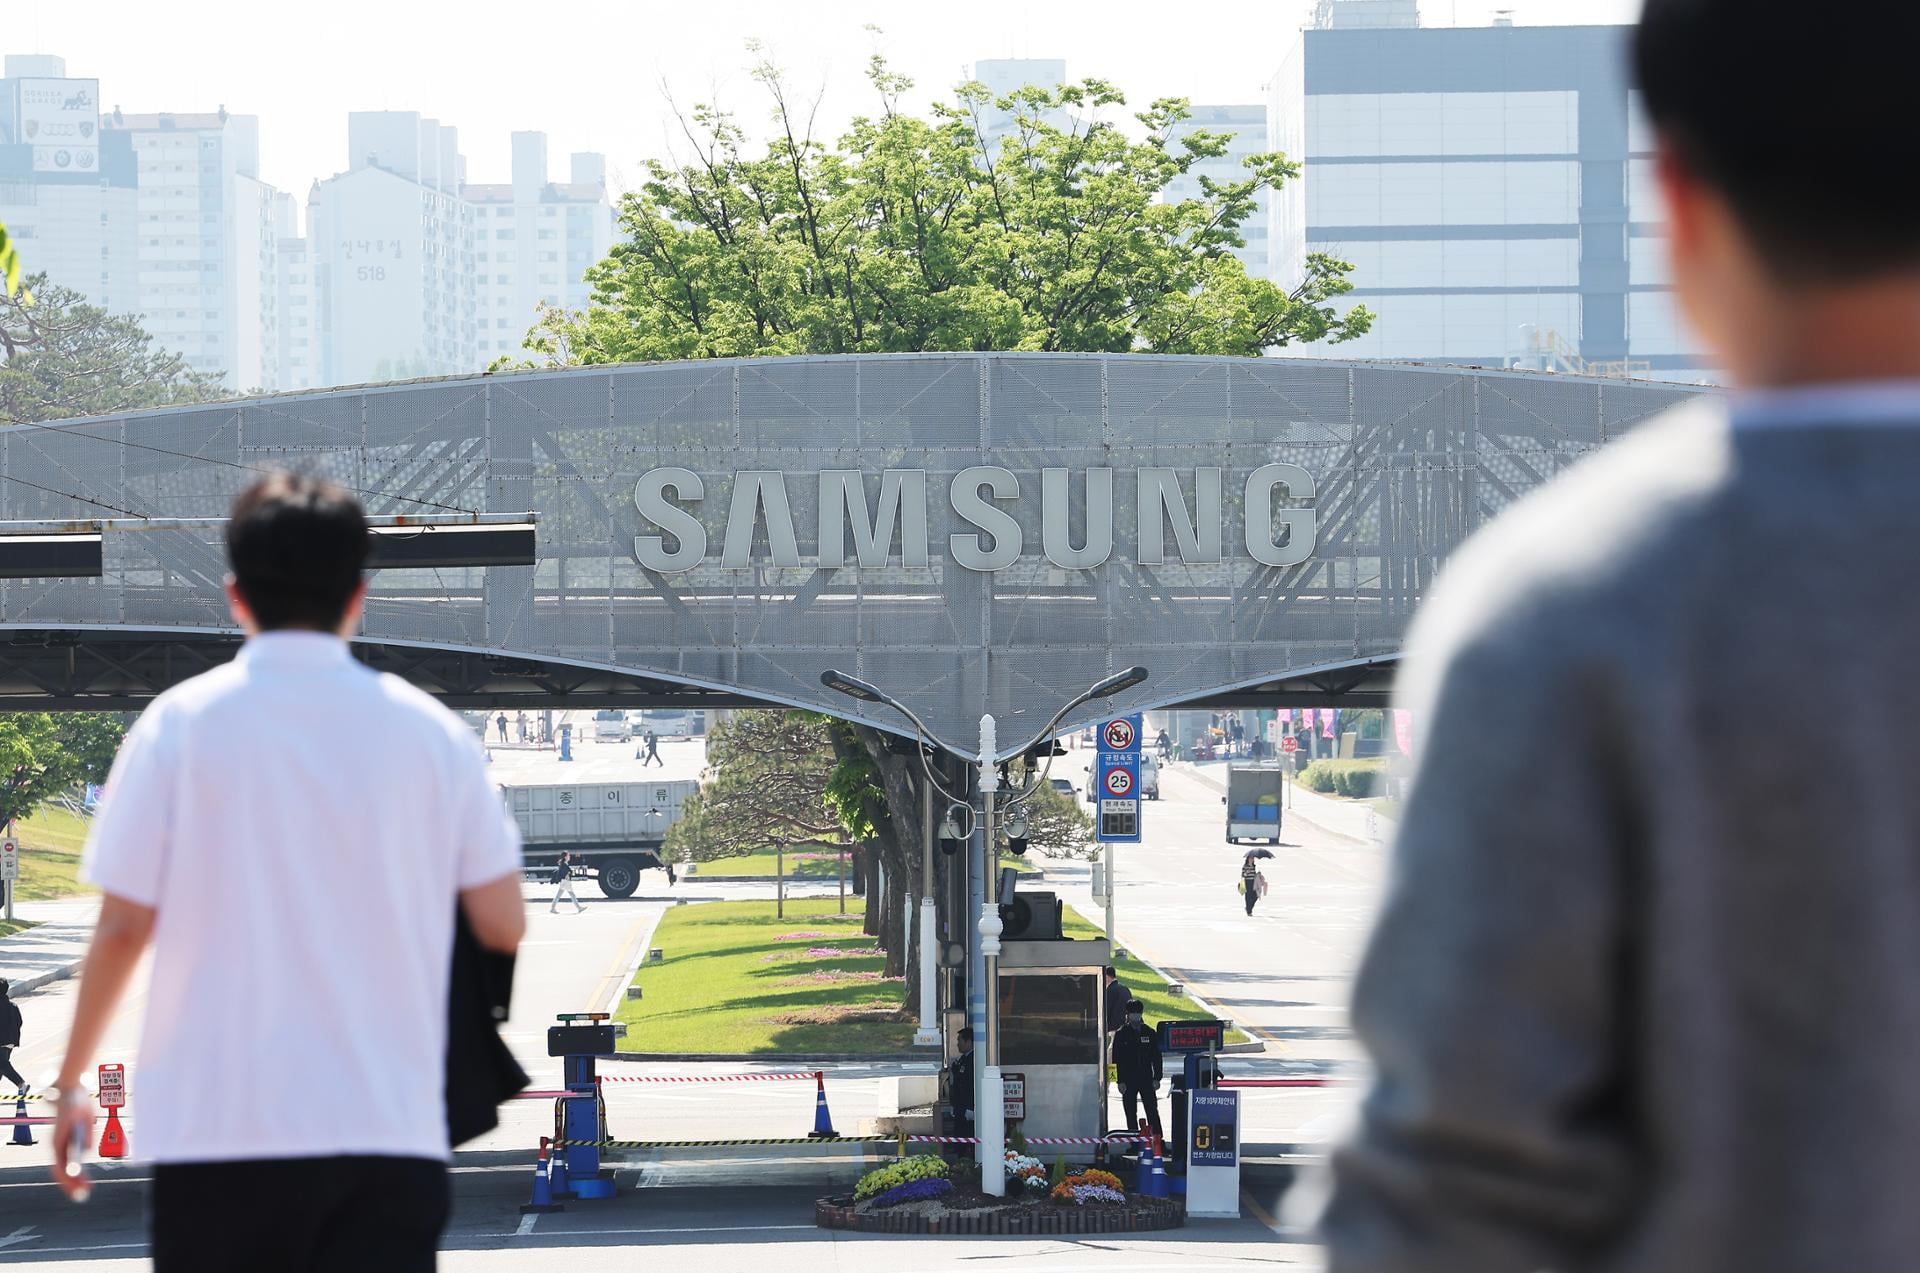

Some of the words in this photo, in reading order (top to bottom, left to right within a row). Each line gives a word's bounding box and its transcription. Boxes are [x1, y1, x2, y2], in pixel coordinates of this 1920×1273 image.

[357, 265, 386, 281] 518
[634, 463, 1317, 573] SAMSUNG
[1105, 754, 1133, 762] 규정속도
[1111, 775, 1128, 788] 25
